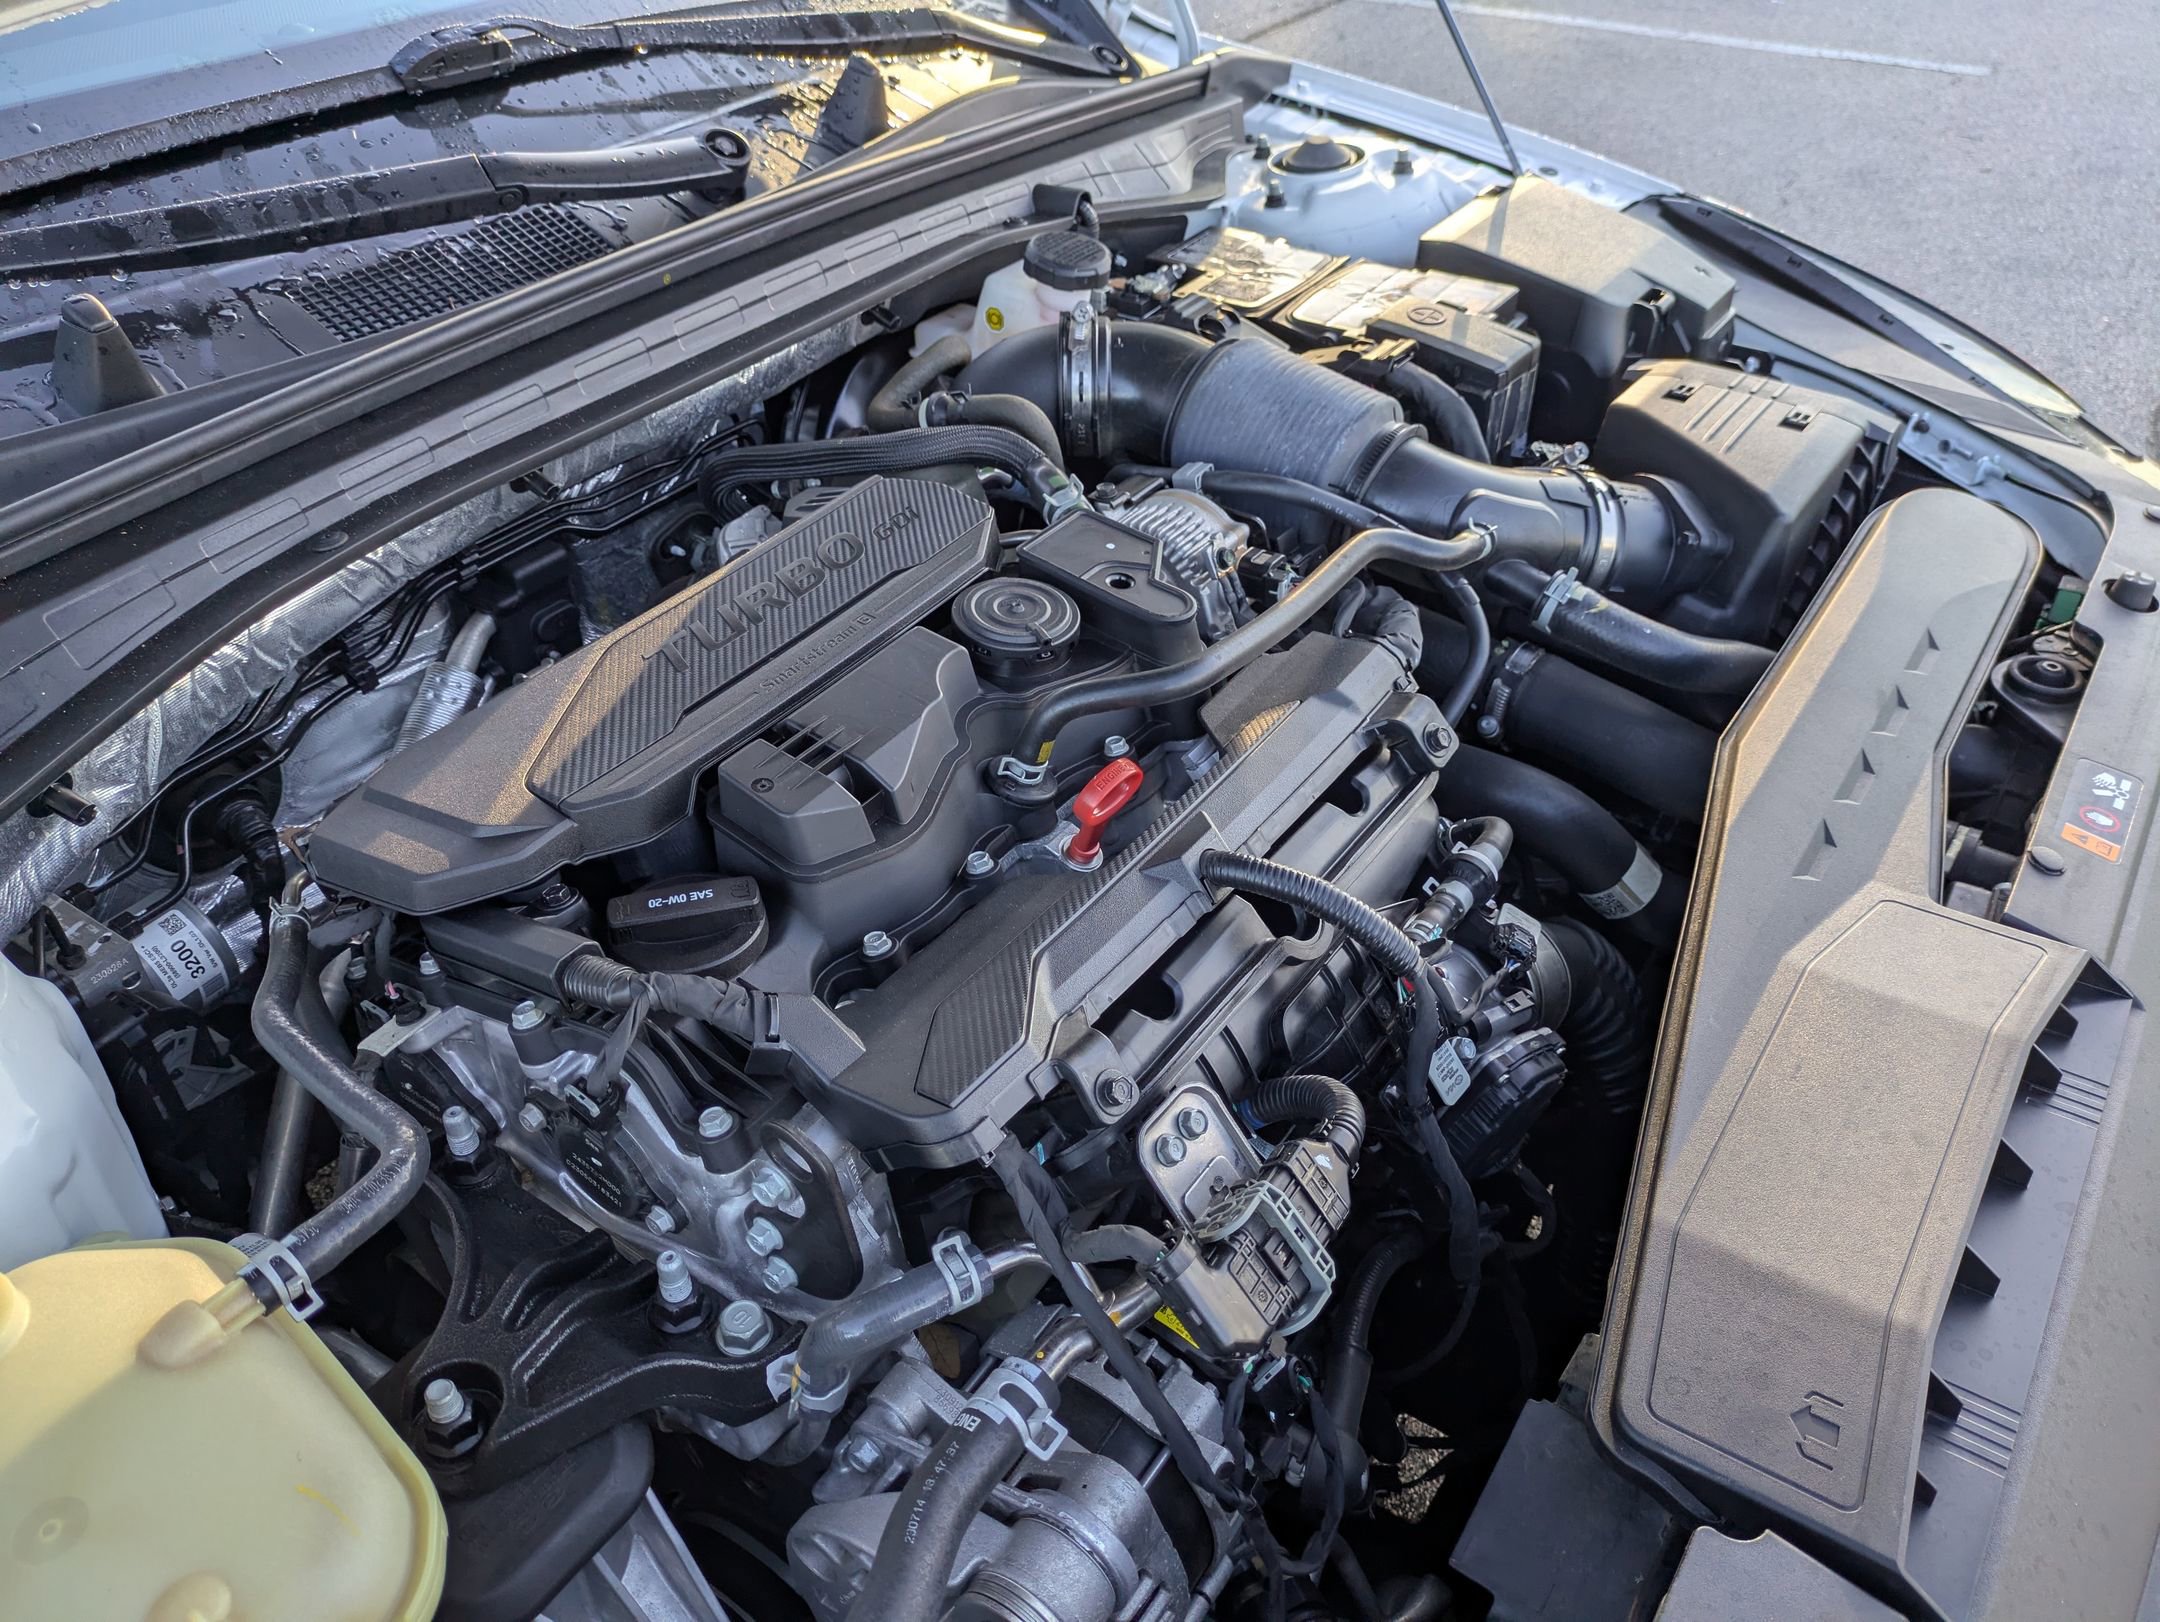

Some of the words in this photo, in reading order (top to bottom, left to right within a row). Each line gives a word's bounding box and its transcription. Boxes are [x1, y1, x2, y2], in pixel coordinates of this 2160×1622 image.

[641, 531, 865, 673] TURBO
[872, 506, 920, 541] GDi
[759, 624, 858, 693] Smartstream
[1095, 765, 1128, 792] ENGINE
[648, 893, 687, 909] 0W-20
[689, 888, 714, 901] SAE
[171, 939, 205, 979] 3200
[953, 1413, 982, 1432] ENG
